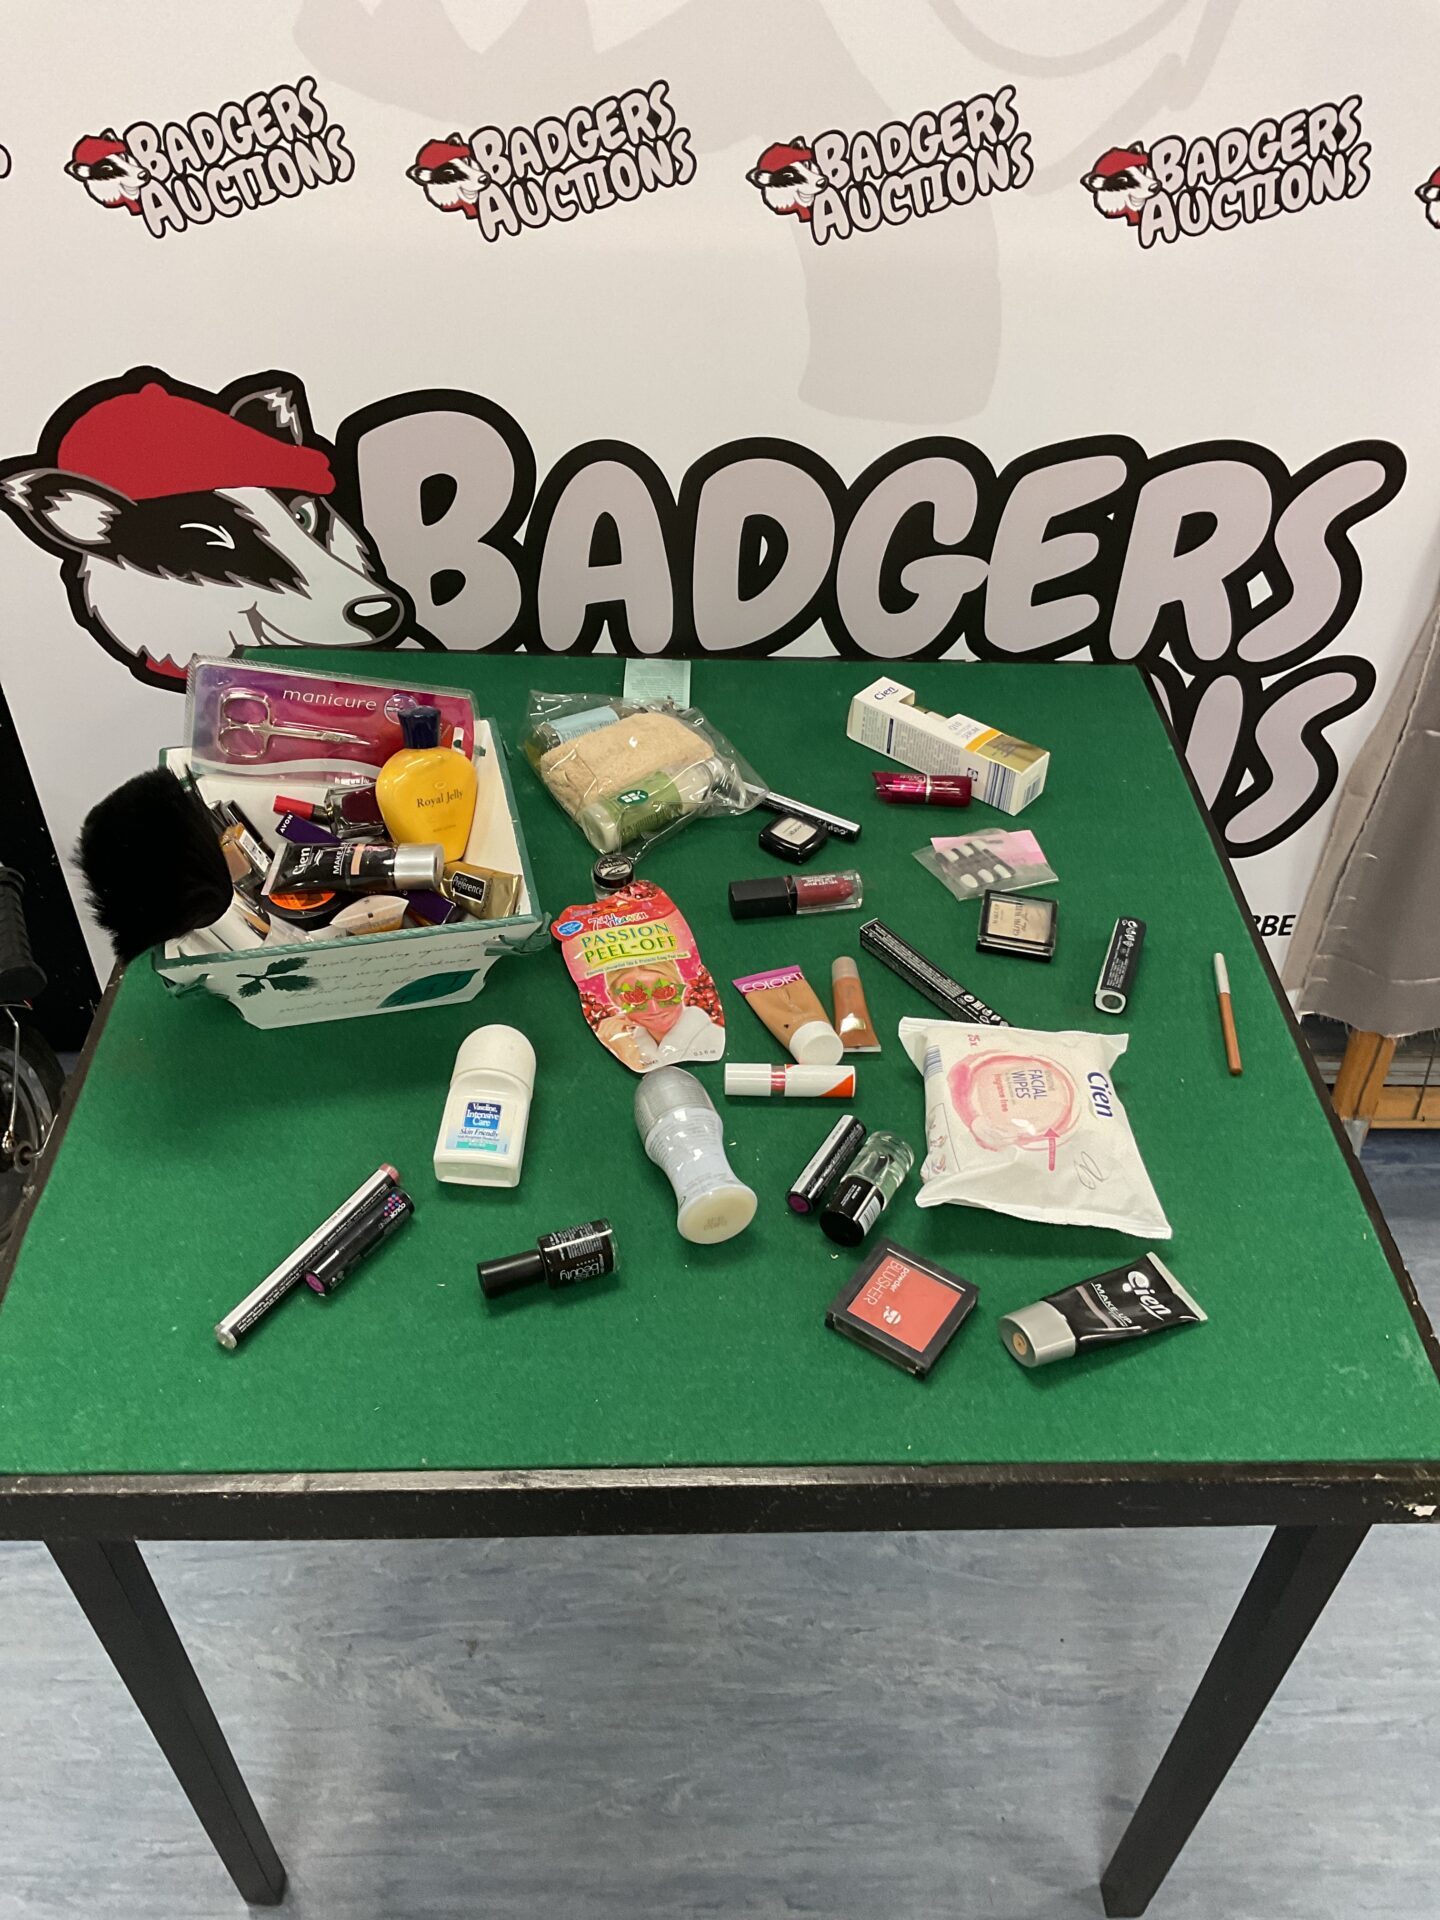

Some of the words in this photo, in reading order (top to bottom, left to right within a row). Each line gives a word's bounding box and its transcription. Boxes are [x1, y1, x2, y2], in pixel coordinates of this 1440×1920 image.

[123, 76, 326, 177] BADGERS
[468, 80, 676, 183] BADGERS
[810, 84, 1016, 186] BADGERS
[1149, 94, 1362, 194] BADGERS
[137, 123, 355, 239] AUCTIONS
[478, 127, 697, 242] AUCTIONS
[810, 132, 1034, 246] AUCTIONS
[1137, 142, 1371, 250] AUCTIONS
[337, 389, 1406, 665] BADGERS
[282, 689, 377, 711] manicure
[874, 686, 895, 700] Cien
[416, 792, 444, 808] Royal
[446, 788, 463, 804] Jelly
[280, 814, 294, 834] AVON
[292, 847, 311, 875] Cien
[581, 922, 669, 948] PASSION
[604, 911, 649, 928] Heaven
[584, 935, 676, 963] PEEL-OFF
[992, 1073, 1006, 1099] fragrance
[1000, 1099, 1008, 1112] free
[1011, 1070, 1031, 1099] WIPES
[1027, 1069, 1047, 1100] FACIAL
[1087, 1072, 1113, 1117] Cien
[467, 1109, 500, 1120] Intensive
[472, 1117, 491, 1127] Care
[559, 1262, 600, 1281] beauty
[864, 1260, 903, 1306] BLUSHER
[891, 1267, 910, 1292] powder
[1127, 1270, 1173, 1321] Cien
